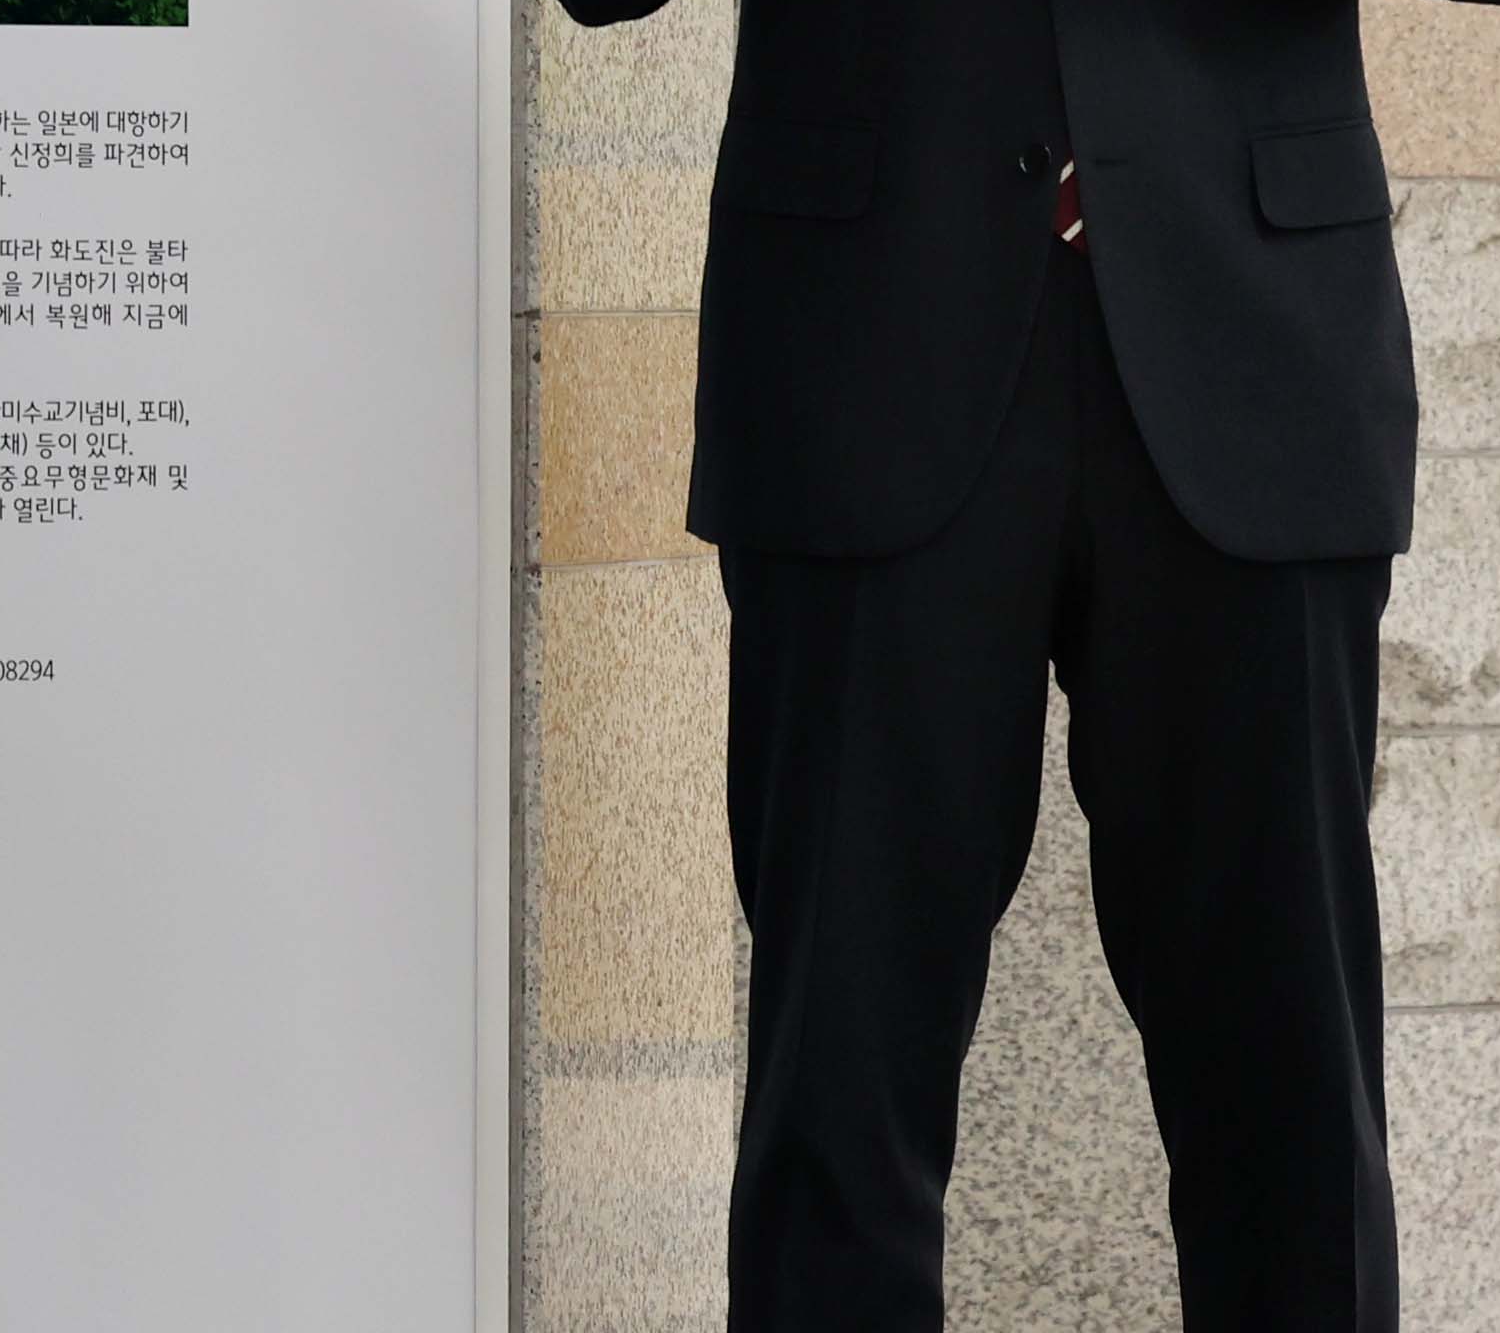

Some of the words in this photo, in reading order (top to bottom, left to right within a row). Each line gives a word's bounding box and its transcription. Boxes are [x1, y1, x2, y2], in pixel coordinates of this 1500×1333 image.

[37, 109, 99, 137] 일본에
[106, 110, 188, 138] 대항하기
[9, 141, 96, 170] 신정희를
[103, 142, 189, 169] 파견하여
[0, 238, 43, 262] 따라
[49, 238, 137, 266] 화도진은
[145, 239, 189, 266] 불타
[31, 270, 116, 298] 기념하기
[125, 270, 189, 295] 위하여
[45, 303, 112, 330] 복원해
[122, 303, 188, 330] 지금에
[137, 399, 190, 428] 포대),
[35, 432, 77, 460] 등이
[85, 432, 134, 459] 있다.
[168, 464, 188, 491] 및
[13, 496, 83, 524] 열린다.
